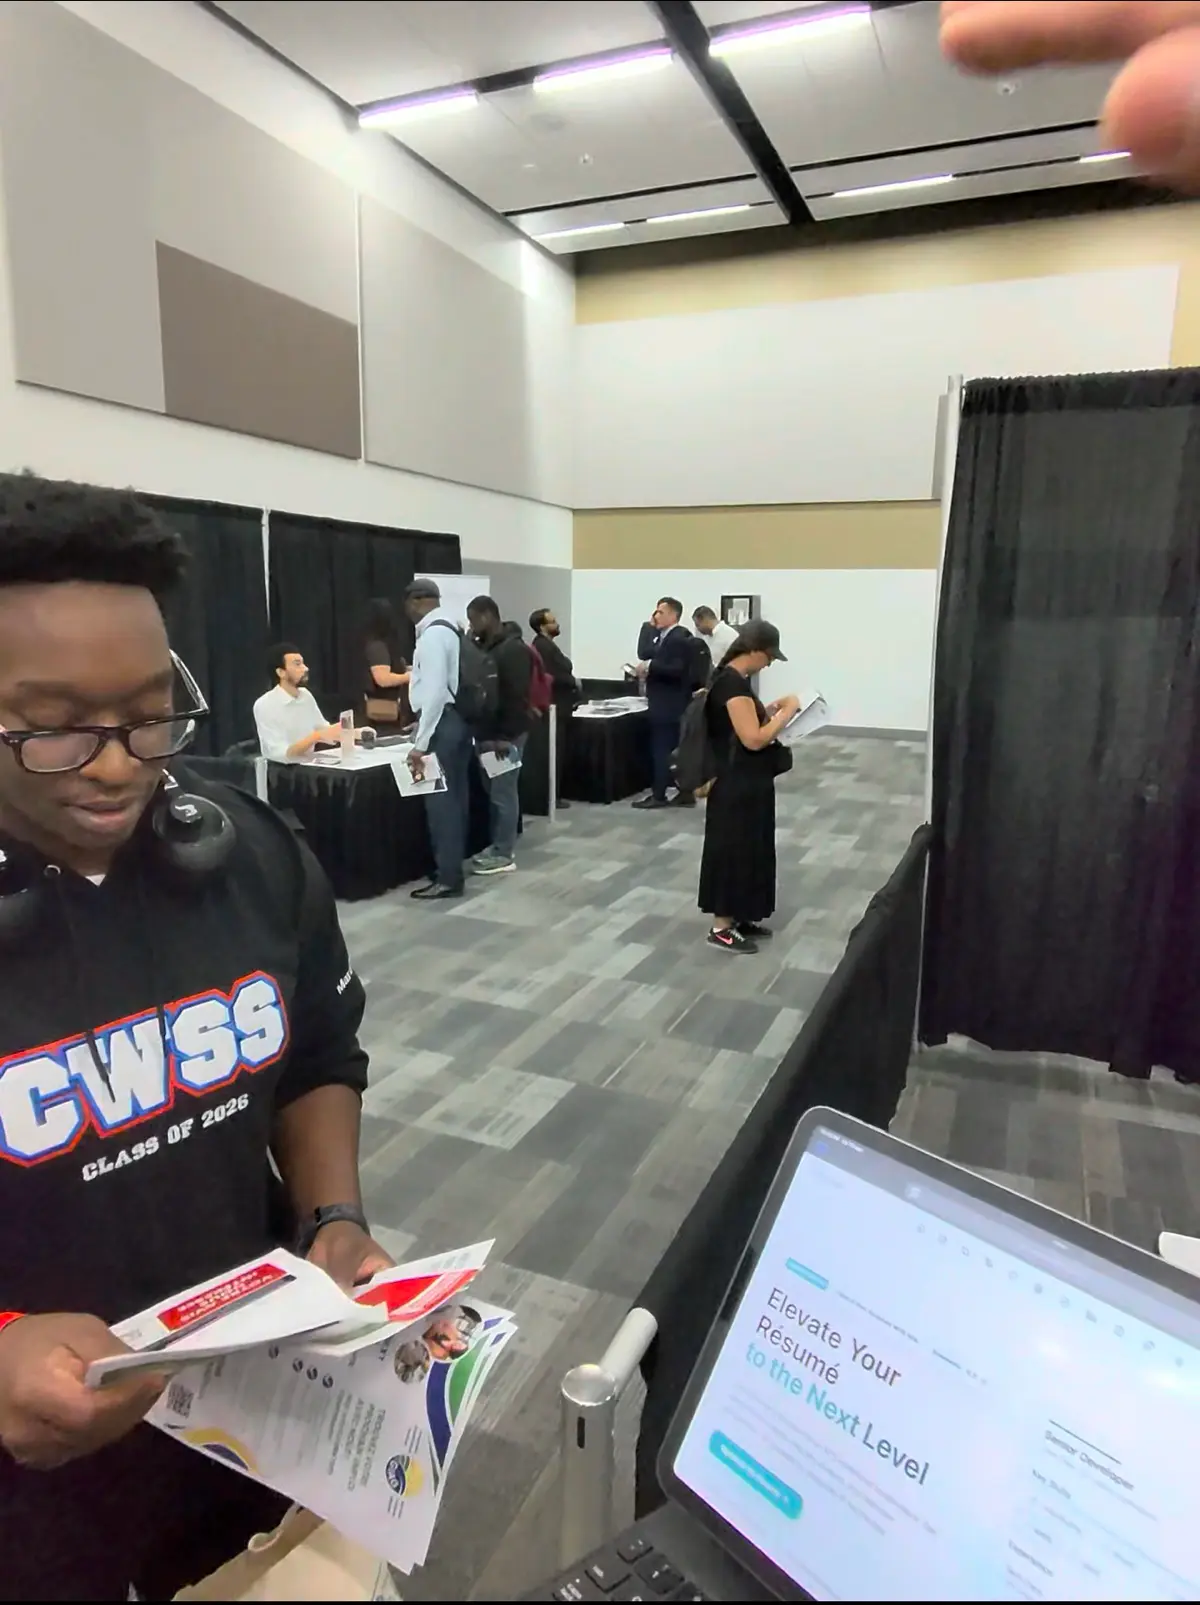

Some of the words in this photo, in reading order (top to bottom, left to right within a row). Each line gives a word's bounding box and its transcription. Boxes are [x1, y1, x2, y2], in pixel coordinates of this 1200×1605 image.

[0, 972, 288, 1165] CWSS
[82, 1136, 160, 1182] CLASS
[167, 1118, 194, 1145] OF
[201, 1093, 249, 1129] 2026
[756, 1315, 840, 1385] Résumé
[767, 1287, 842, 1349] Elevate
[851, 1338, 902, 1387] Your
[746, 1342, 766, 1369] to
[769, 1359, 803, 1396] the
[806, 1383, 860, 1438] Next
[862, 1423, 930, 1486] Level
